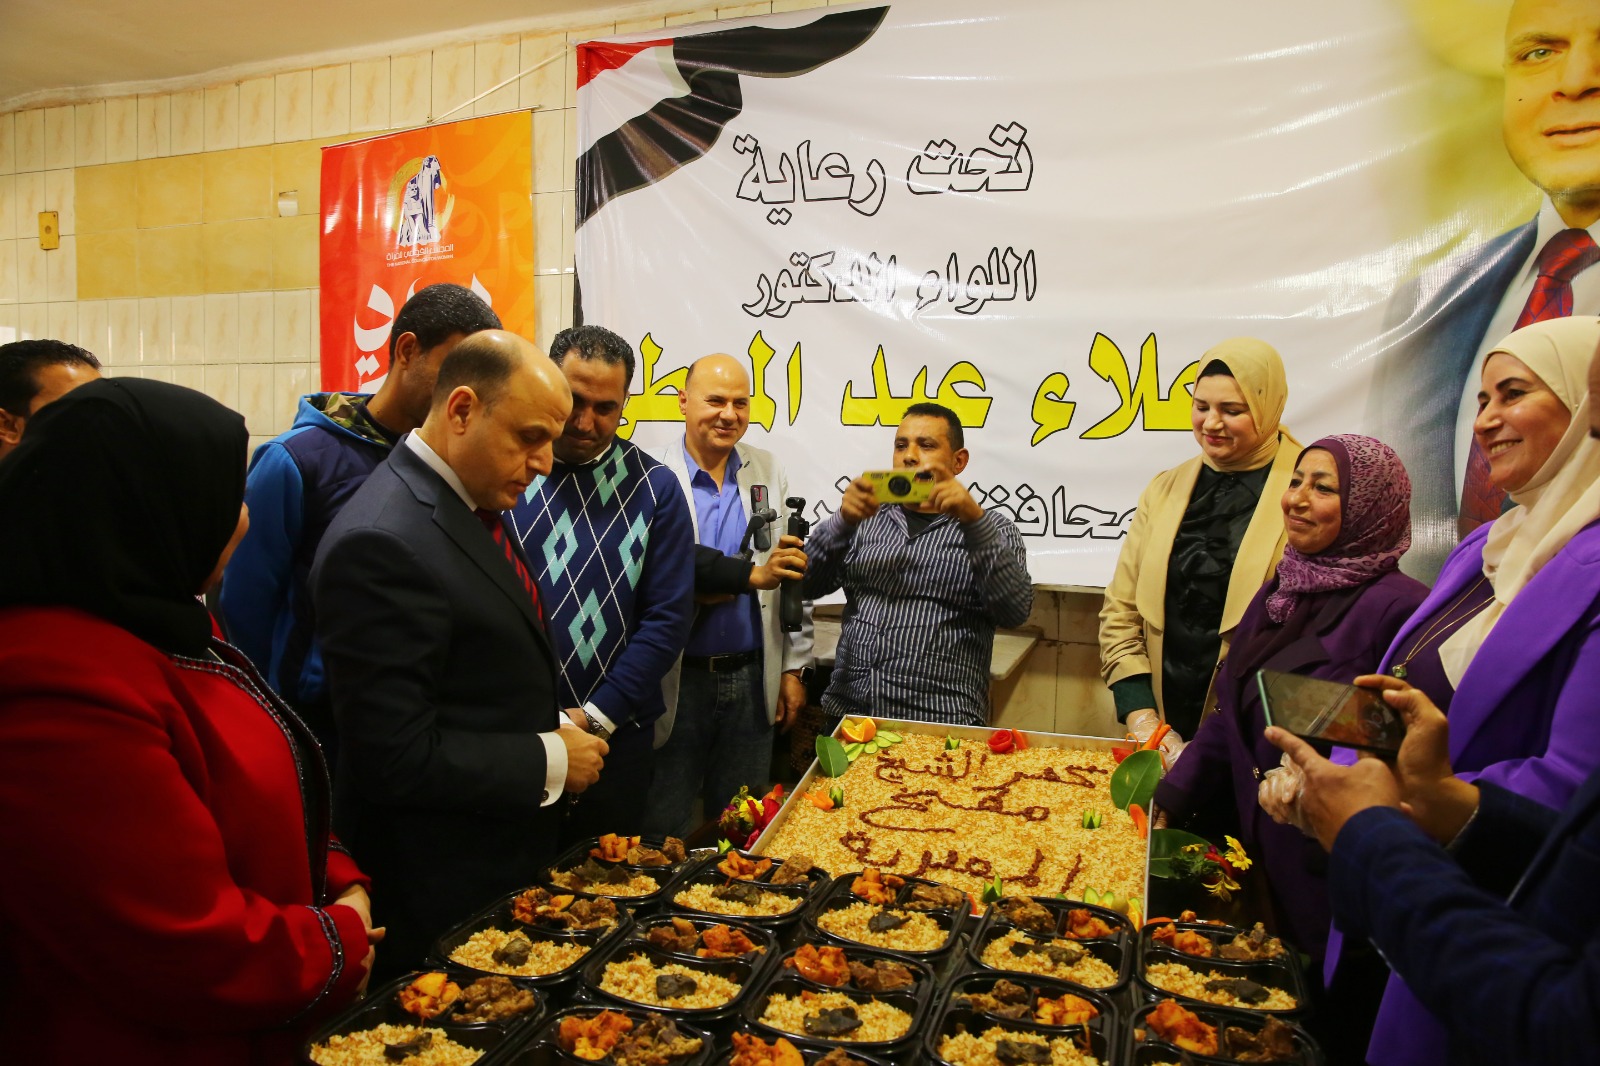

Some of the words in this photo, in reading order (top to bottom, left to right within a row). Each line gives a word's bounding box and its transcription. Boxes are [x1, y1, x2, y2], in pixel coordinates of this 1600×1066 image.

[732, 134, 887, 226] رعاية
[906, 121, 1034, 195] تحت
[742, 251, 898, 318] الدكتور
[916, 247, 1037, 315] اللواء
[841, 344, 992, 428] عبد
